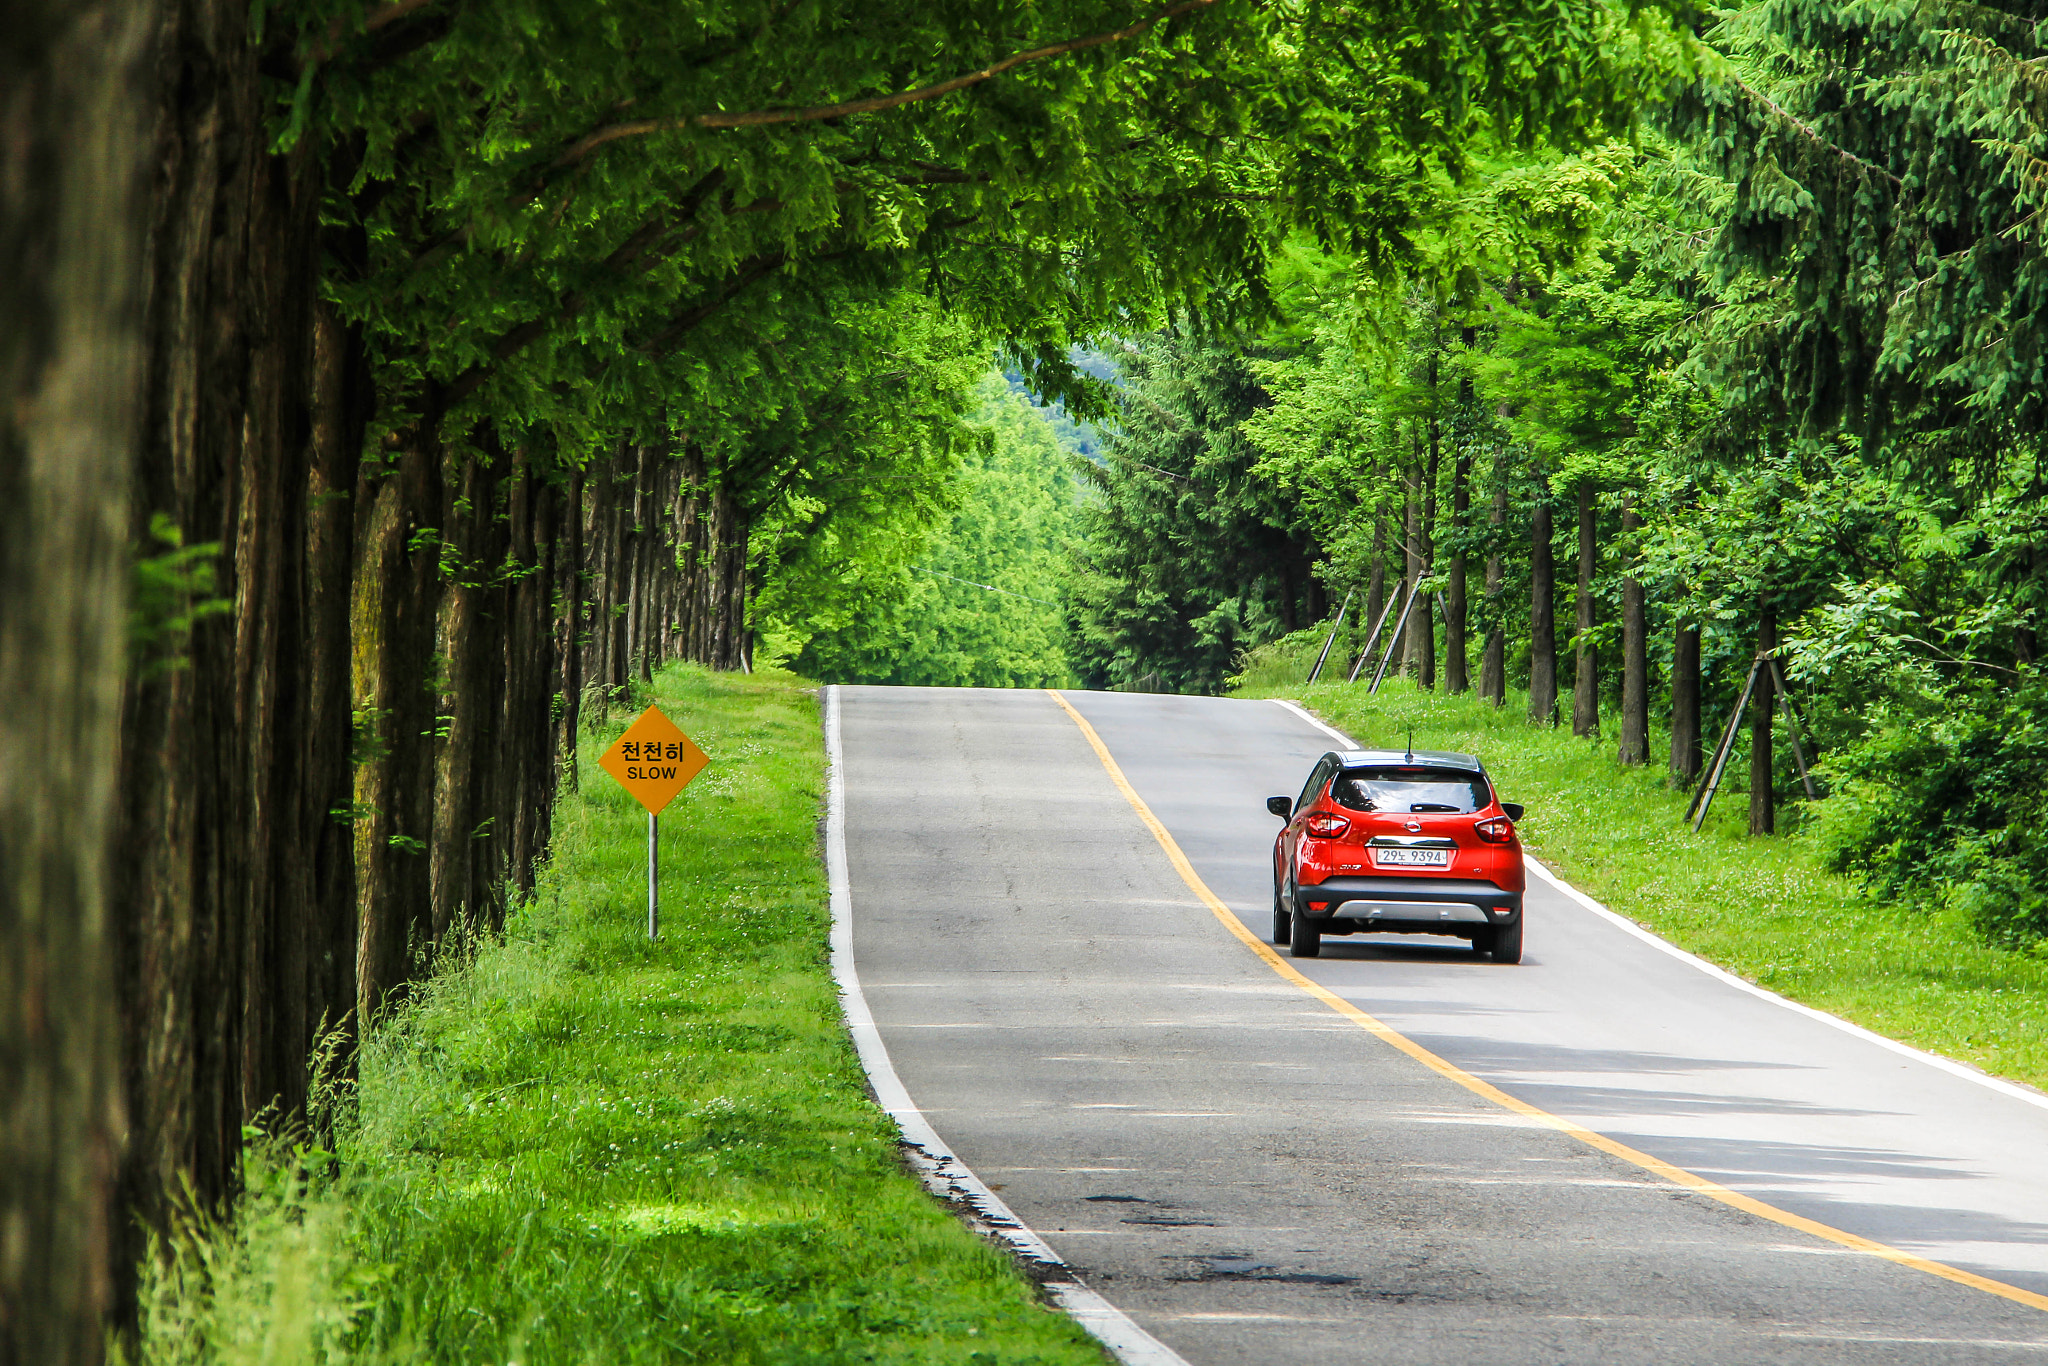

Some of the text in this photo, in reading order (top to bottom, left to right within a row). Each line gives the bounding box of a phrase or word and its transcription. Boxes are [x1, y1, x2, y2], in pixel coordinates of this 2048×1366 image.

[621, 741, 683, 762] 천천히
[627, 766, 677, 779] SLOW
[1383, 850, 1441, 862] 29노 9394
